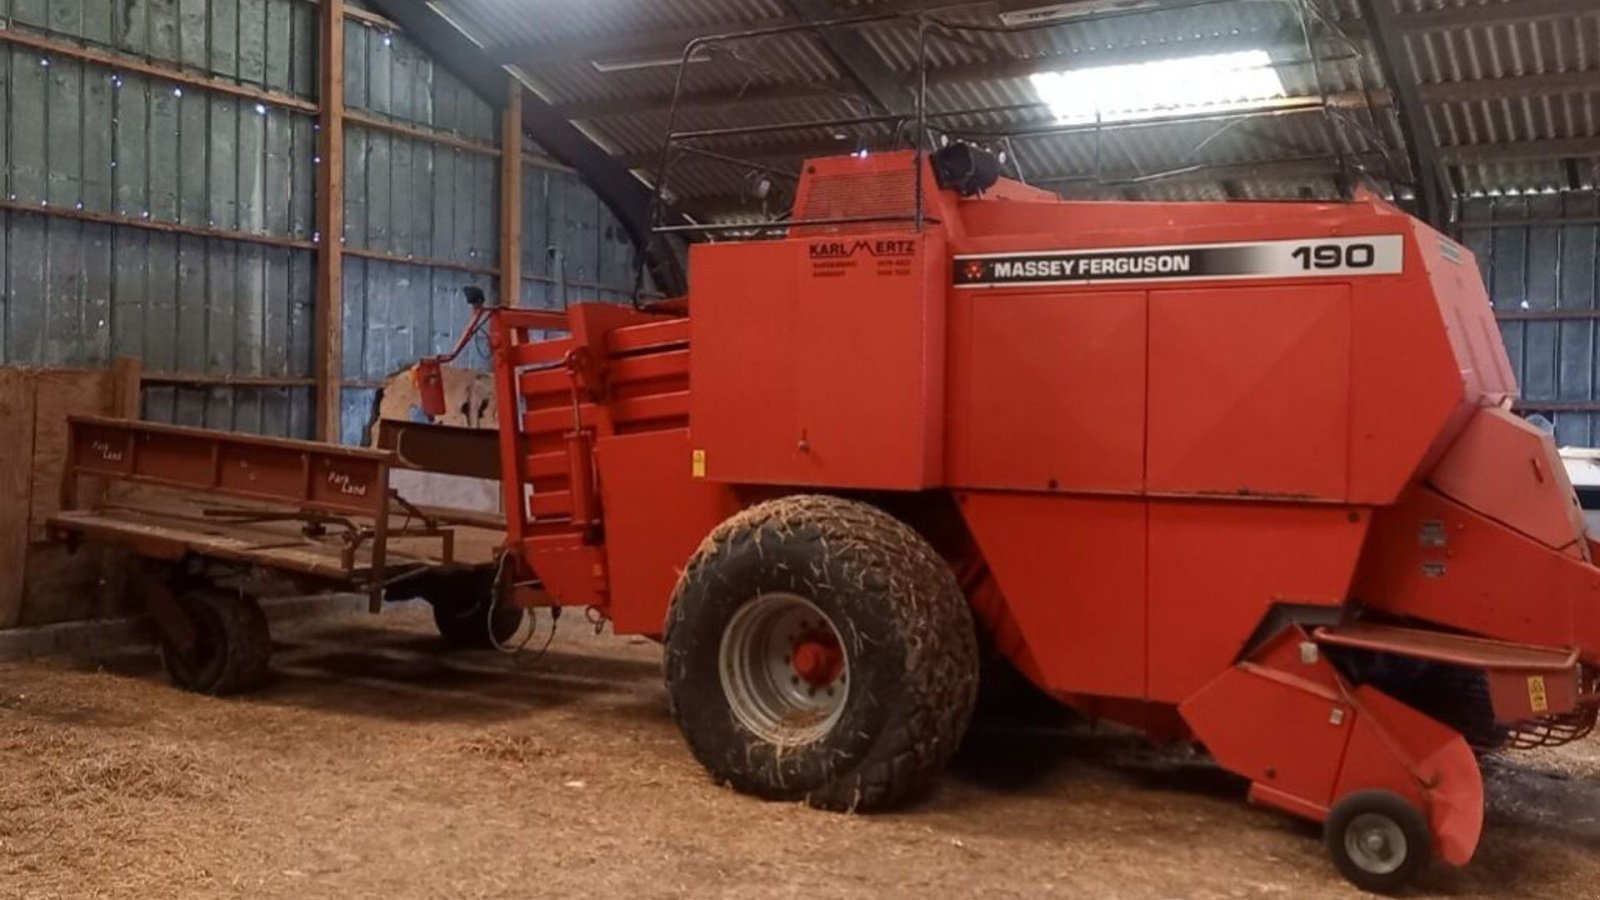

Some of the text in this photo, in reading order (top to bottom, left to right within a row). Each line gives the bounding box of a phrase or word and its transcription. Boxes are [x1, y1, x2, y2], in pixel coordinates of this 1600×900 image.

[809, 242, 848, 256] KARL
[1291, 243, 1375, 270] 190
[994, 254, 1190, 278] MASSEY FERGUSON
